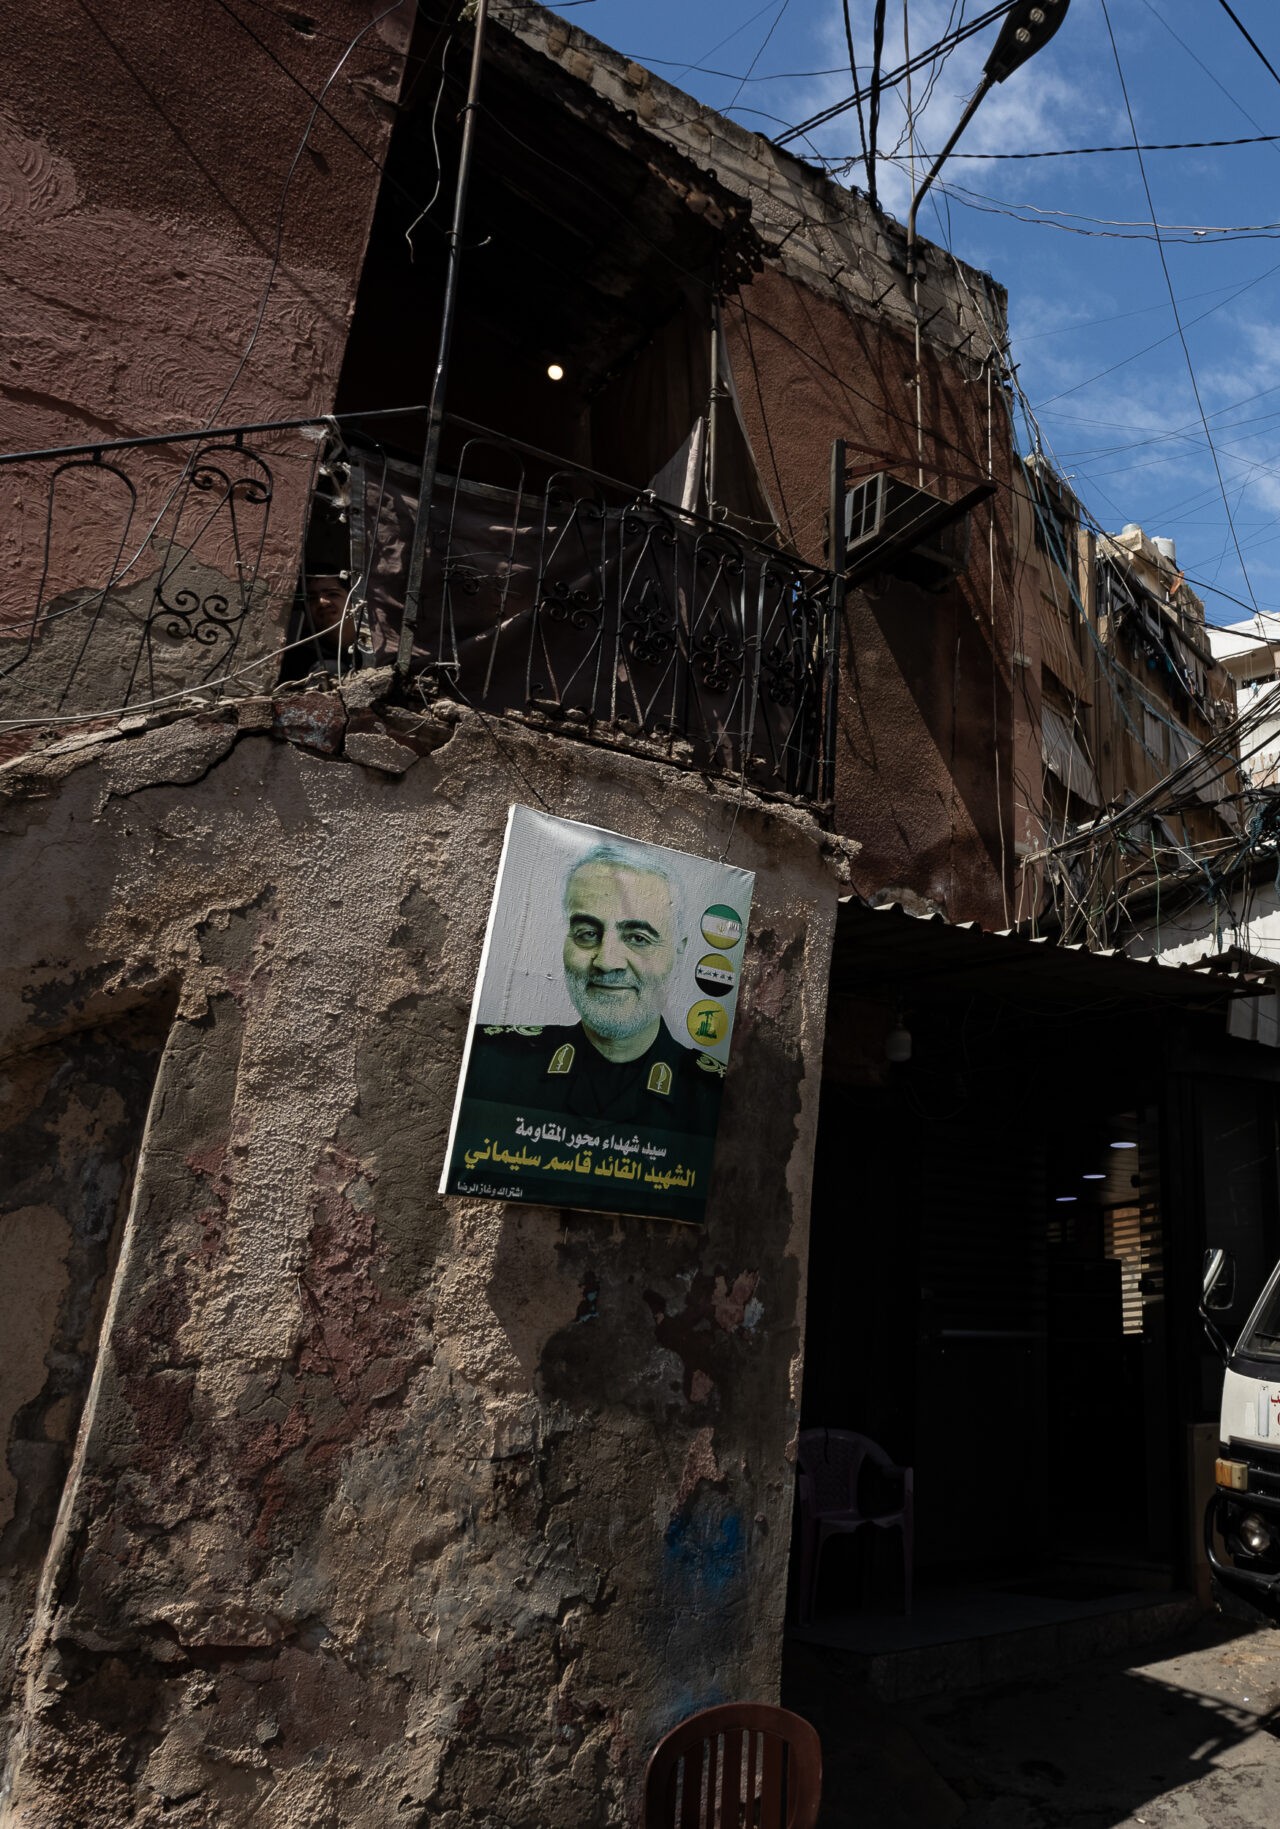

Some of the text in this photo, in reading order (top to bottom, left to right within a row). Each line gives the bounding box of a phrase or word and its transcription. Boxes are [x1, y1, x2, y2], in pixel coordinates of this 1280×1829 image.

[515, 1117, 667, 1161] سيد شهداء محور المقاومة
[464, 1138, 697, 1190] الشهيد القائد قاسم سليماني
